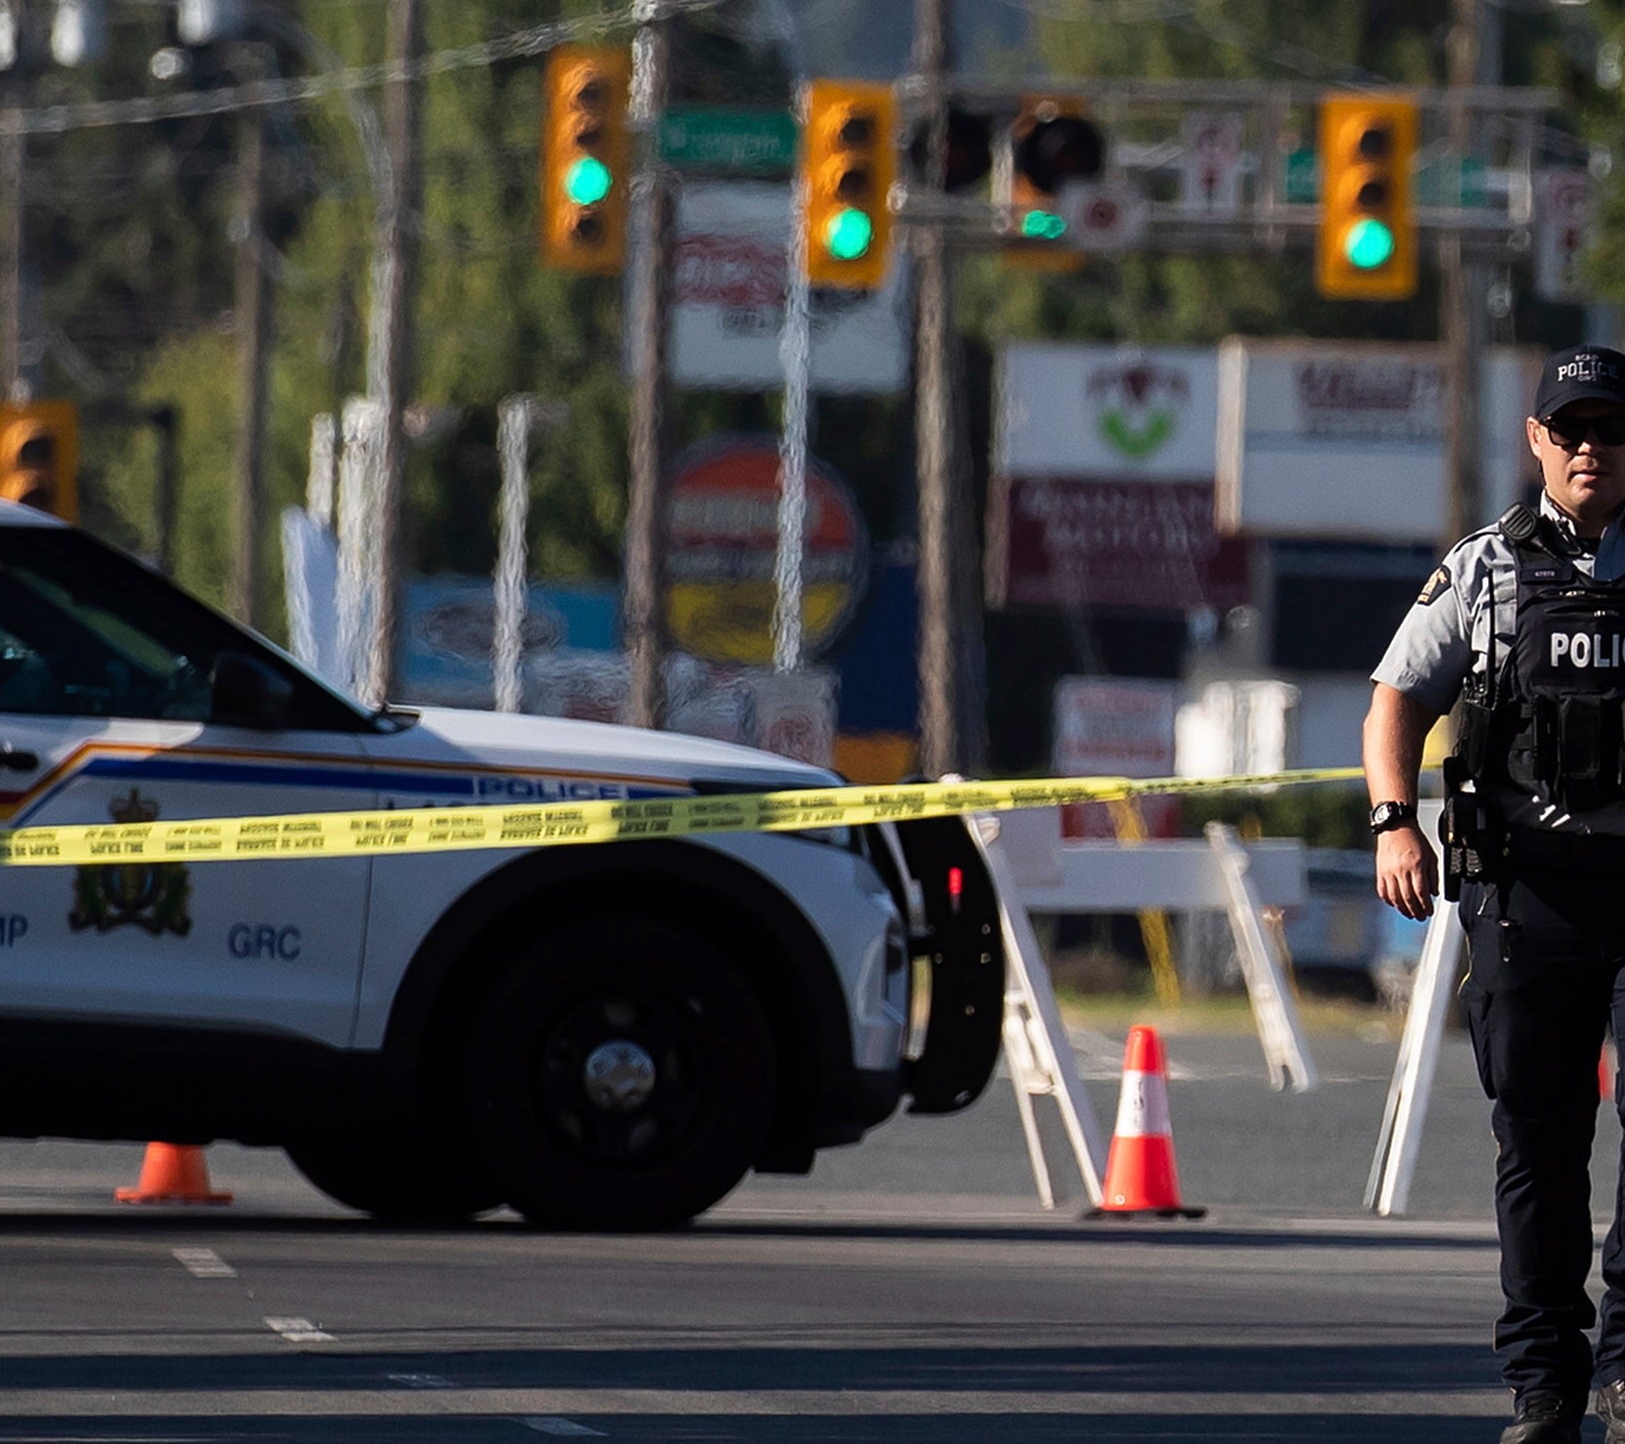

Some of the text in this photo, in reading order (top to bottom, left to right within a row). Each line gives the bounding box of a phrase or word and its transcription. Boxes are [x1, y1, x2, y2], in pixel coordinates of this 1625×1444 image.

[1557, 361, 1618, 382] POLICE
[478, 779, 623, 800] POLICE
[228, 923, 302, 961] GRC
